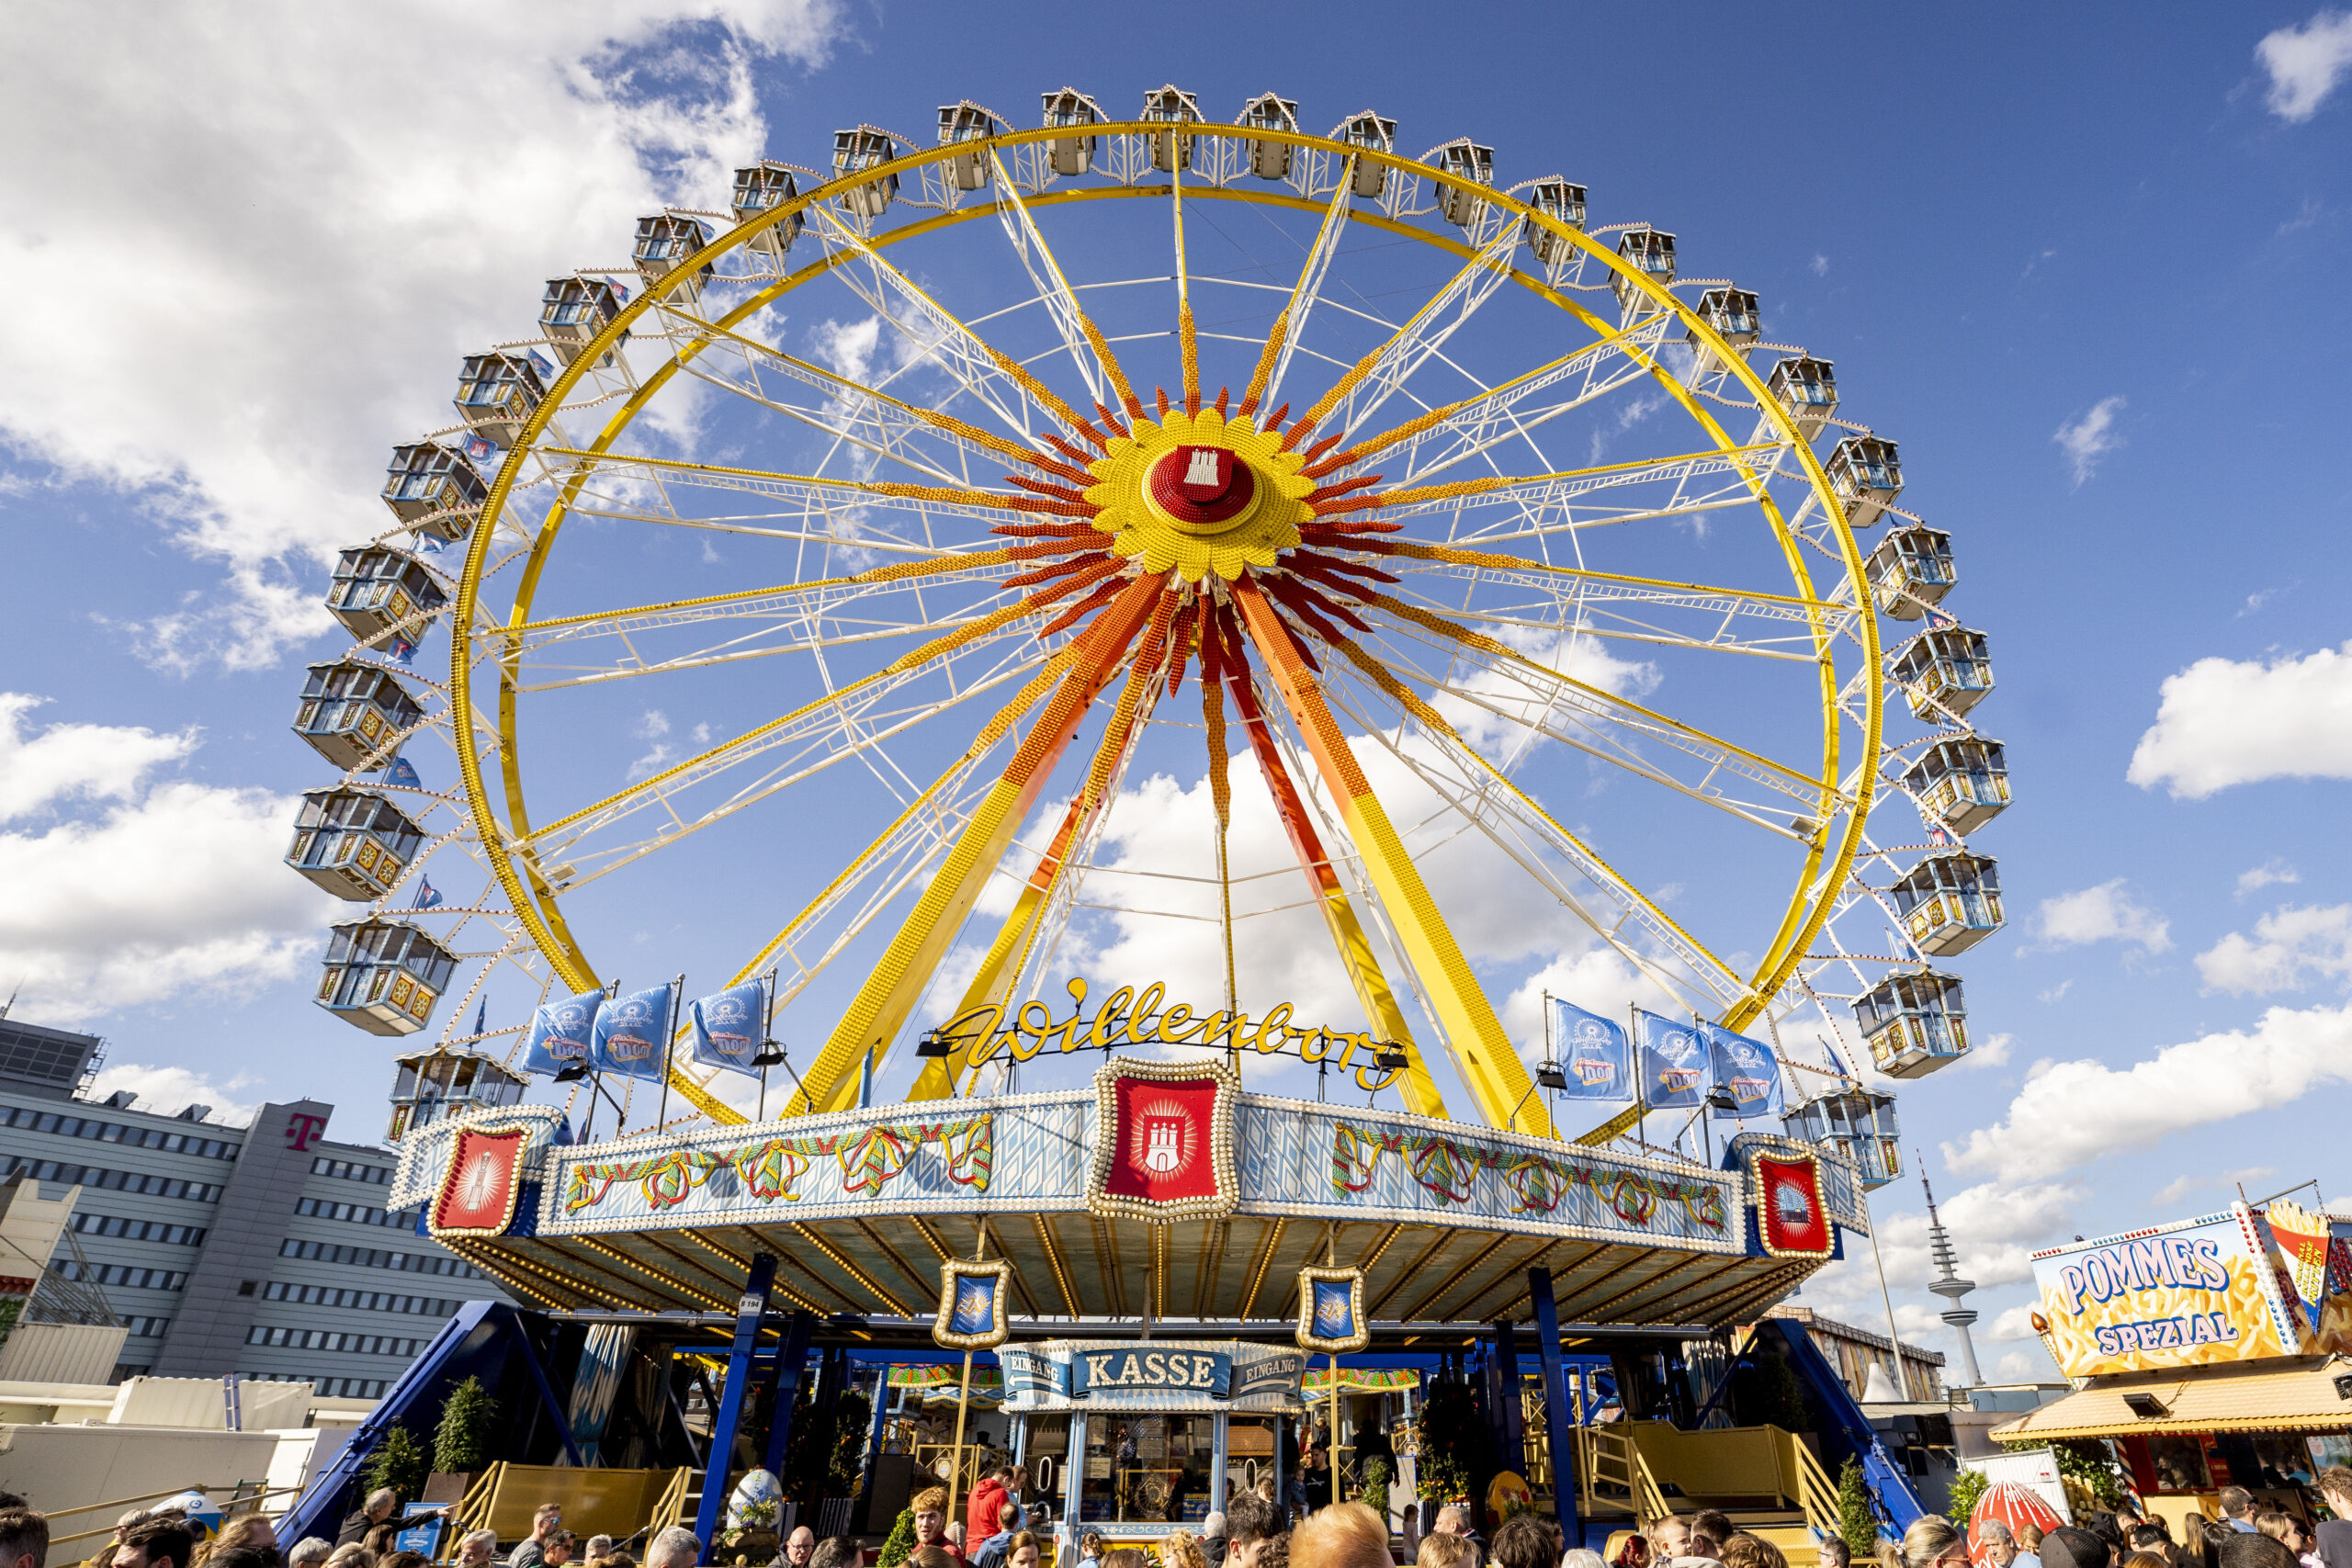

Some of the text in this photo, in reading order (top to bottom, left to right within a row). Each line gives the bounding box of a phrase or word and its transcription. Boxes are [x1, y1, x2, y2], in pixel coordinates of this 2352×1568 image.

[933, 976, 1408, 1091] Willenborg
[287, 1113, 327, 1152] T
[2060, 1238, 2229, 1315] POMMES
[2308, 1247, 2323, 1307] FRITTEN
[2096, 1312, 2239, 1356] SPEZIAL
[1011, 1356, 1058, 1381] EINGANG
[1086, 1353, 1216, 1387] KASSE
[1246, 1358, 1295, 1382] EINGANG
